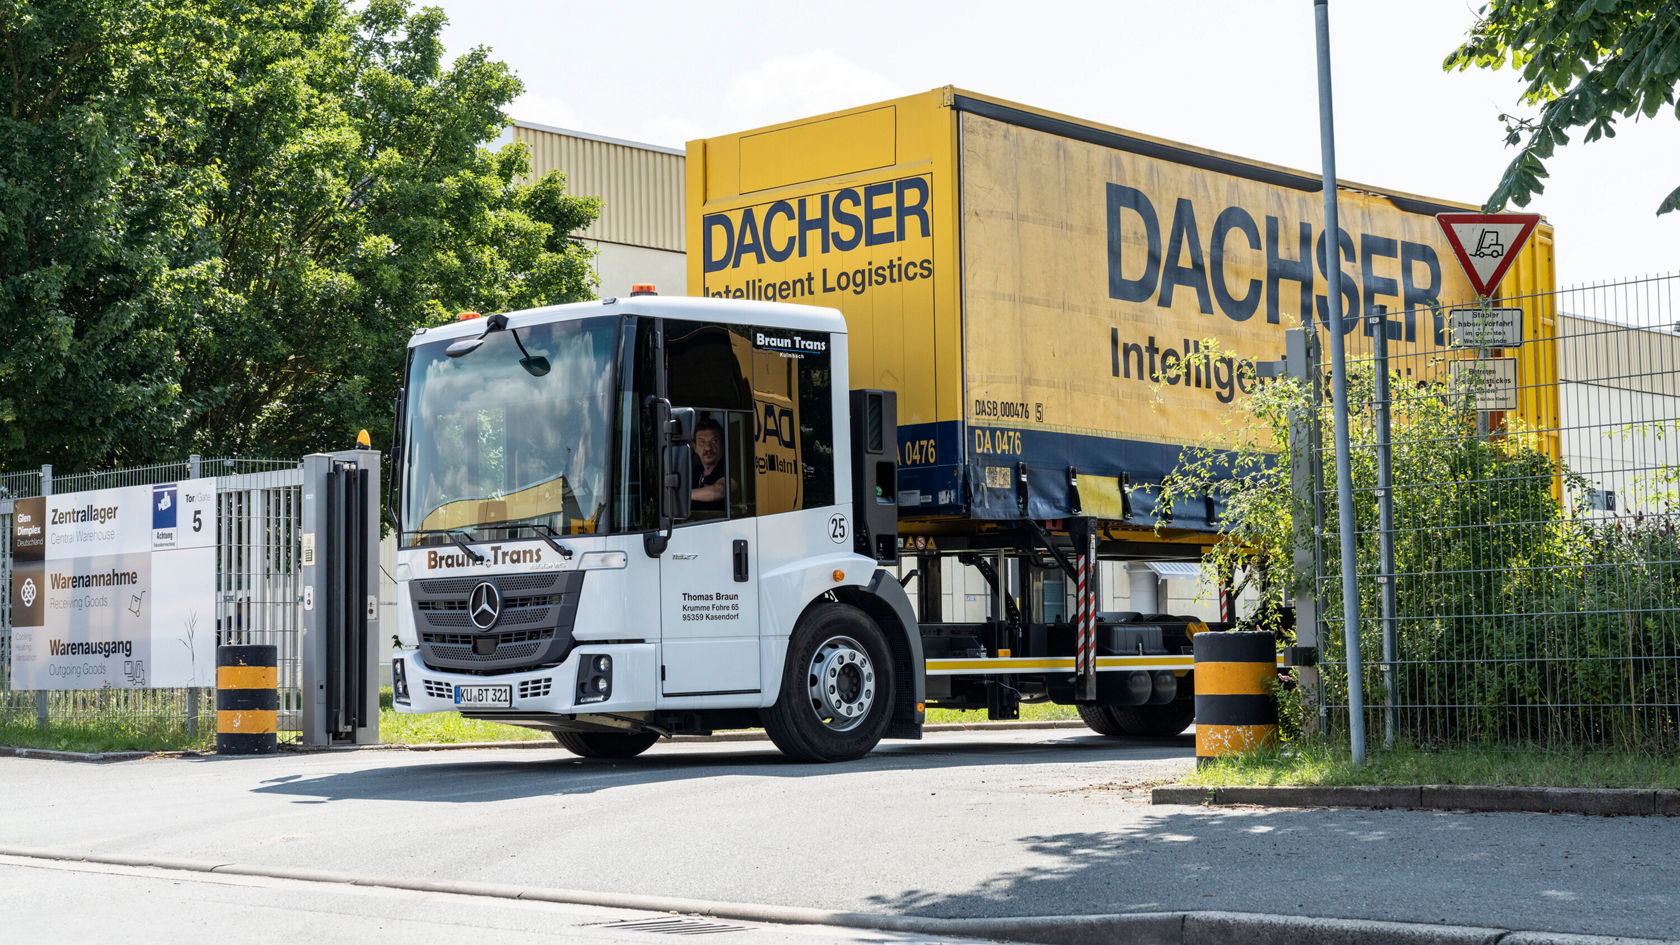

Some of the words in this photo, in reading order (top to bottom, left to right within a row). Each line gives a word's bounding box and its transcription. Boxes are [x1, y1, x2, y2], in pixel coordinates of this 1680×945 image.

[704, 177, 931, 273] DACHSER
[1105, 182, 1445, 346] DACHSER
[822, 257, 933, 295] Logistics
[756, 333, 791, 347] Braun
[793, 336, 826, 350] Trans
[1111, 327, 1287, 404] Intellige
[975, 400, 998, 416] DASB
[1000, 401, 1030, 419] 000476
[1036, 404, 1043, 421] 5
[975, 429, 993, 454] DA
[995, 430, 1022, 455] 0476
[905, 439, 936, 465] 0476
[17, 513, 31, 523] Glen
[51, 504, 119, 525] Zentrallager
[192, 509, 202, 533] 5
[17, 525, 41, 536] Dimplex
[50, 532, 74, 544] Central
[75, 530, 115, 543] Warehouse
[831, 518, 845, 538] 25
[491, 546, 542, 565] Trans
[50, 568, 138, 590] Warenannahme
[50, 596, 83, 610] Receiving
[84, 595, 108, 608] Goods
[682, 593, 714, 601] Thomas
[715, 592, 739, 600] Braun
[682, 604, 711, 612] Krumme
[682, 613, 704, 621] 95359
[49, 639, 132, 658] Warenausgang
[49, 663, 81, 678] Outgoing
[82, 662, 106, 675] Goods
[460, 688, 473, 702] KU
[477, 688, 490, 702] BT
[491, 688, 509, 702] 321
